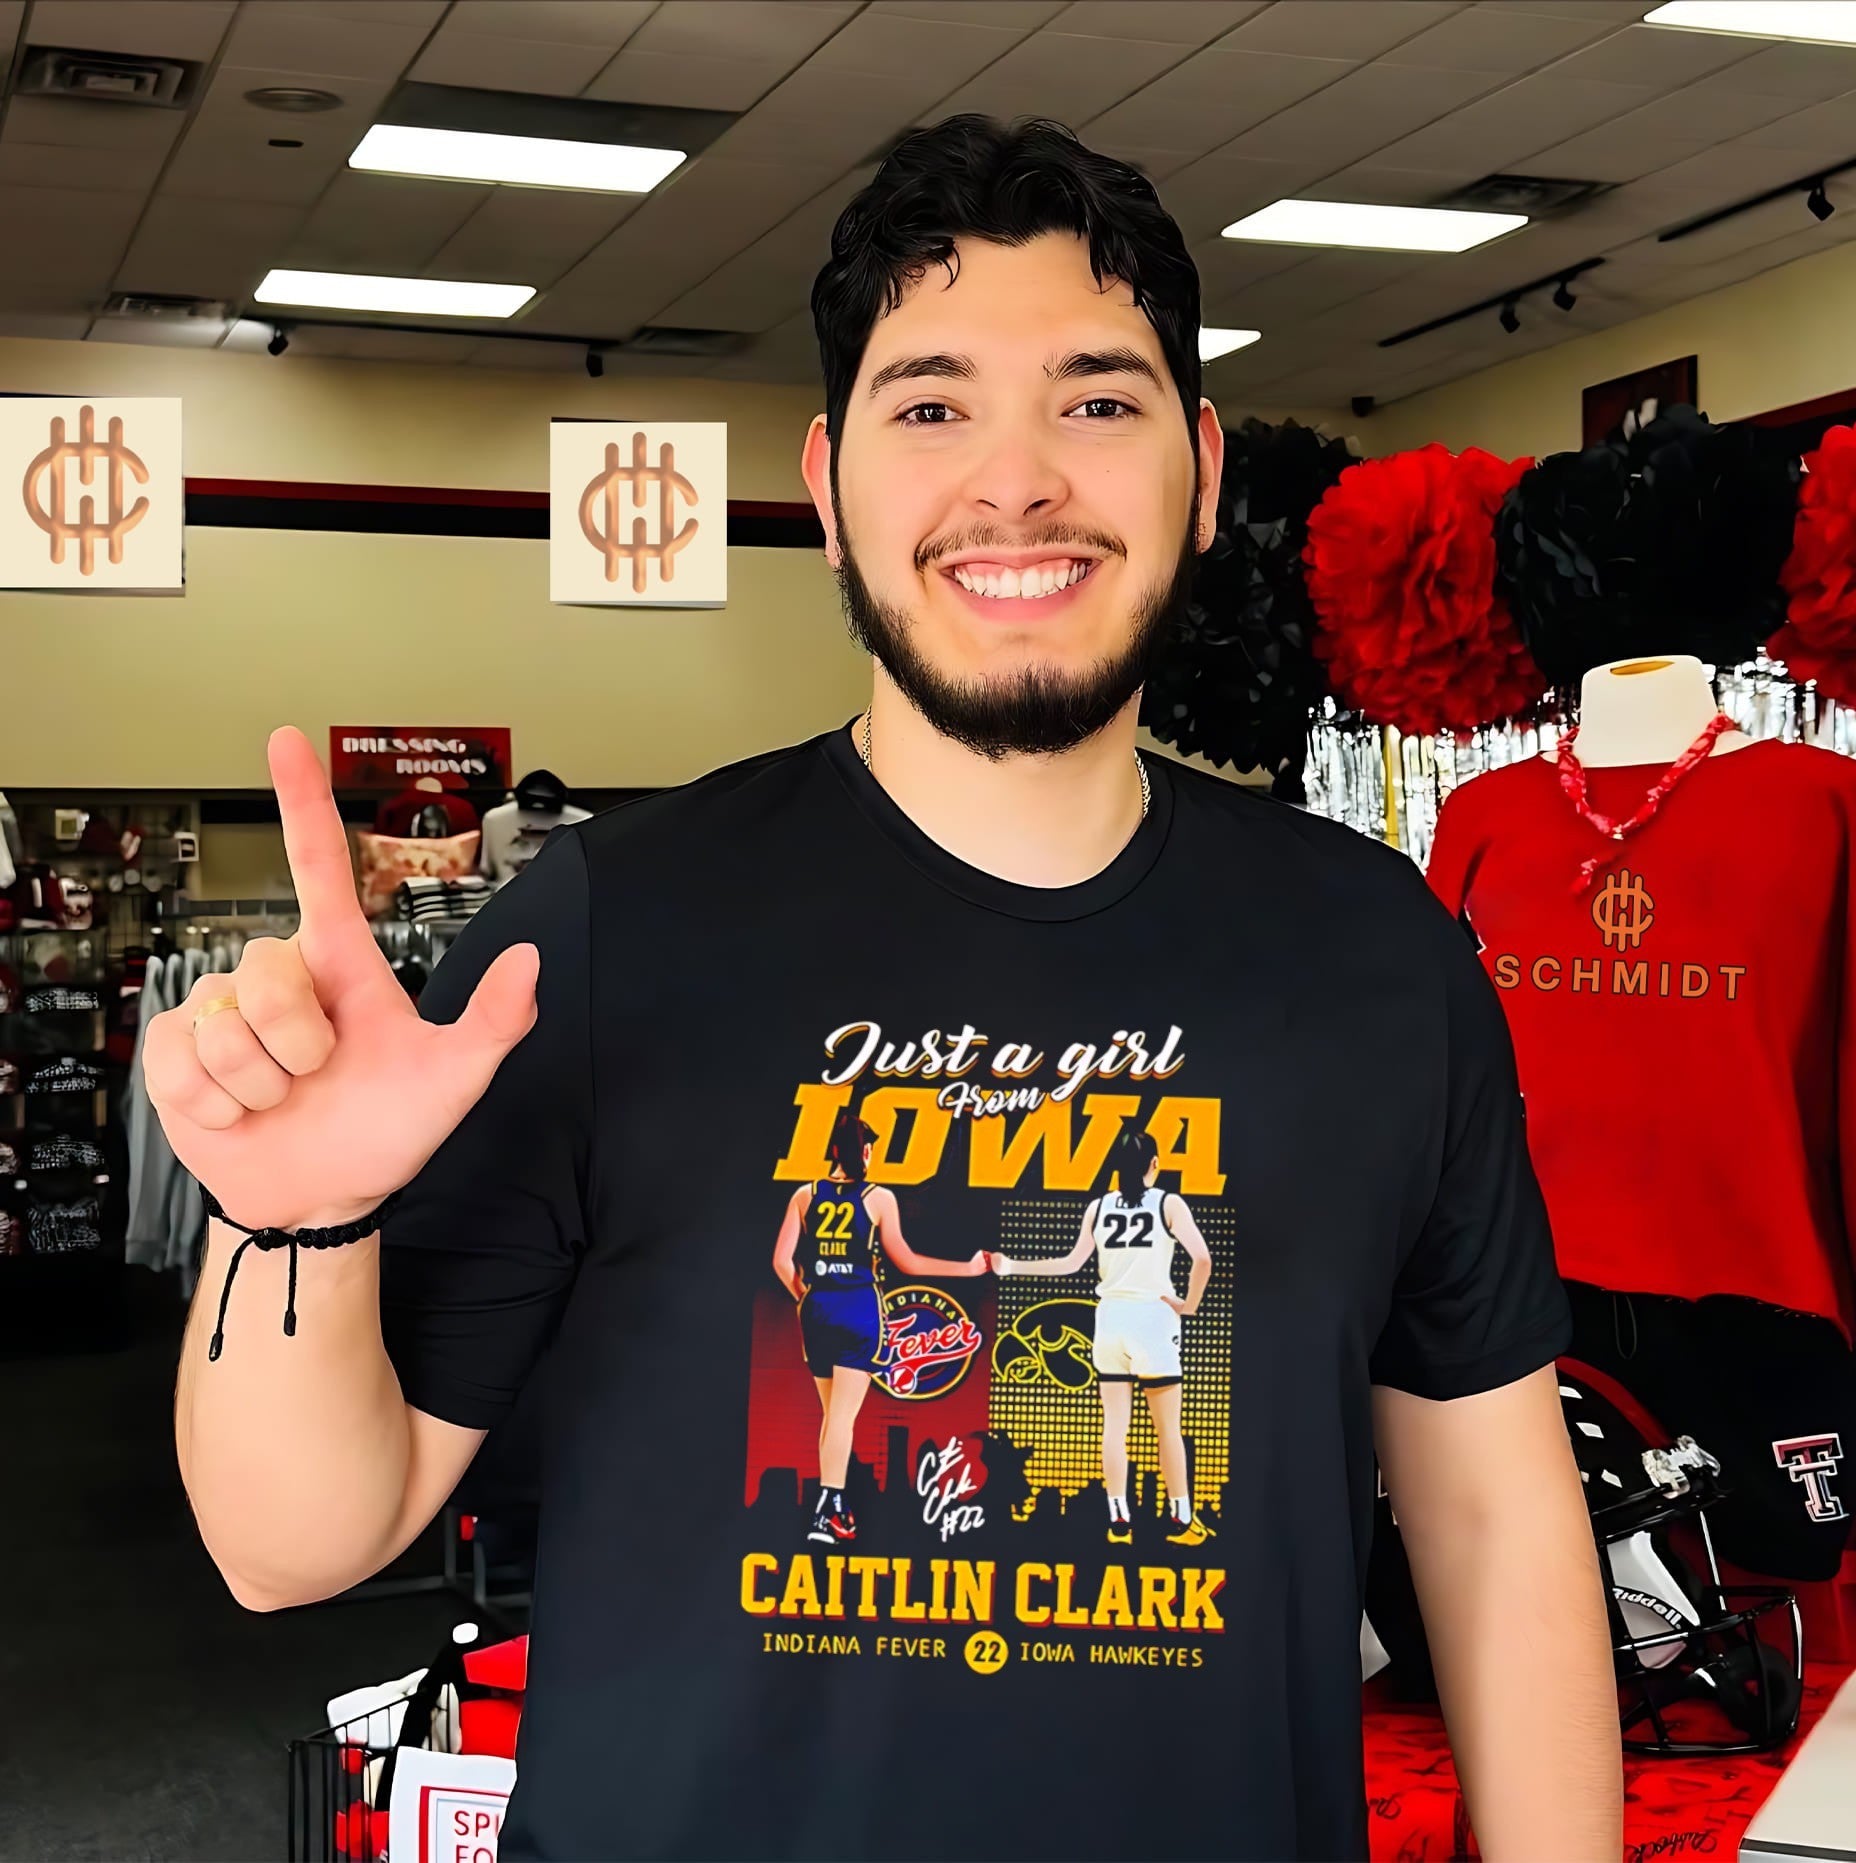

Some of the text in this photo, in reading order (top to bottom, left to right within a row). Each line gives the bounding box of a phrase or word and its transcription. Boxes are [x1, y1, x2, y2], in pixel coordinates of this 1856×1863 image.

[342, 737, 467, 753] DRESSING
[396, 758, 487, 775] ROOMS
[1494, 953, 1747, 1000] SCHMIDT
[821, 1020, 1185, 1103] Just a girl
[937, 1081, 1046, 1119] From
[772, 1082, 1228, 1196] IOWA
[815, 1200, 855, 1240] 22
[1103, 1211, 1154, 1249] 22
[886, 1313, 982, 1360] Fever
[741, 1553, 1226, 1634] CAITLIN CLARK
[763, 1632, 1204, 1668] INDIANA FEVER 22 IOWA HAWKEYES
